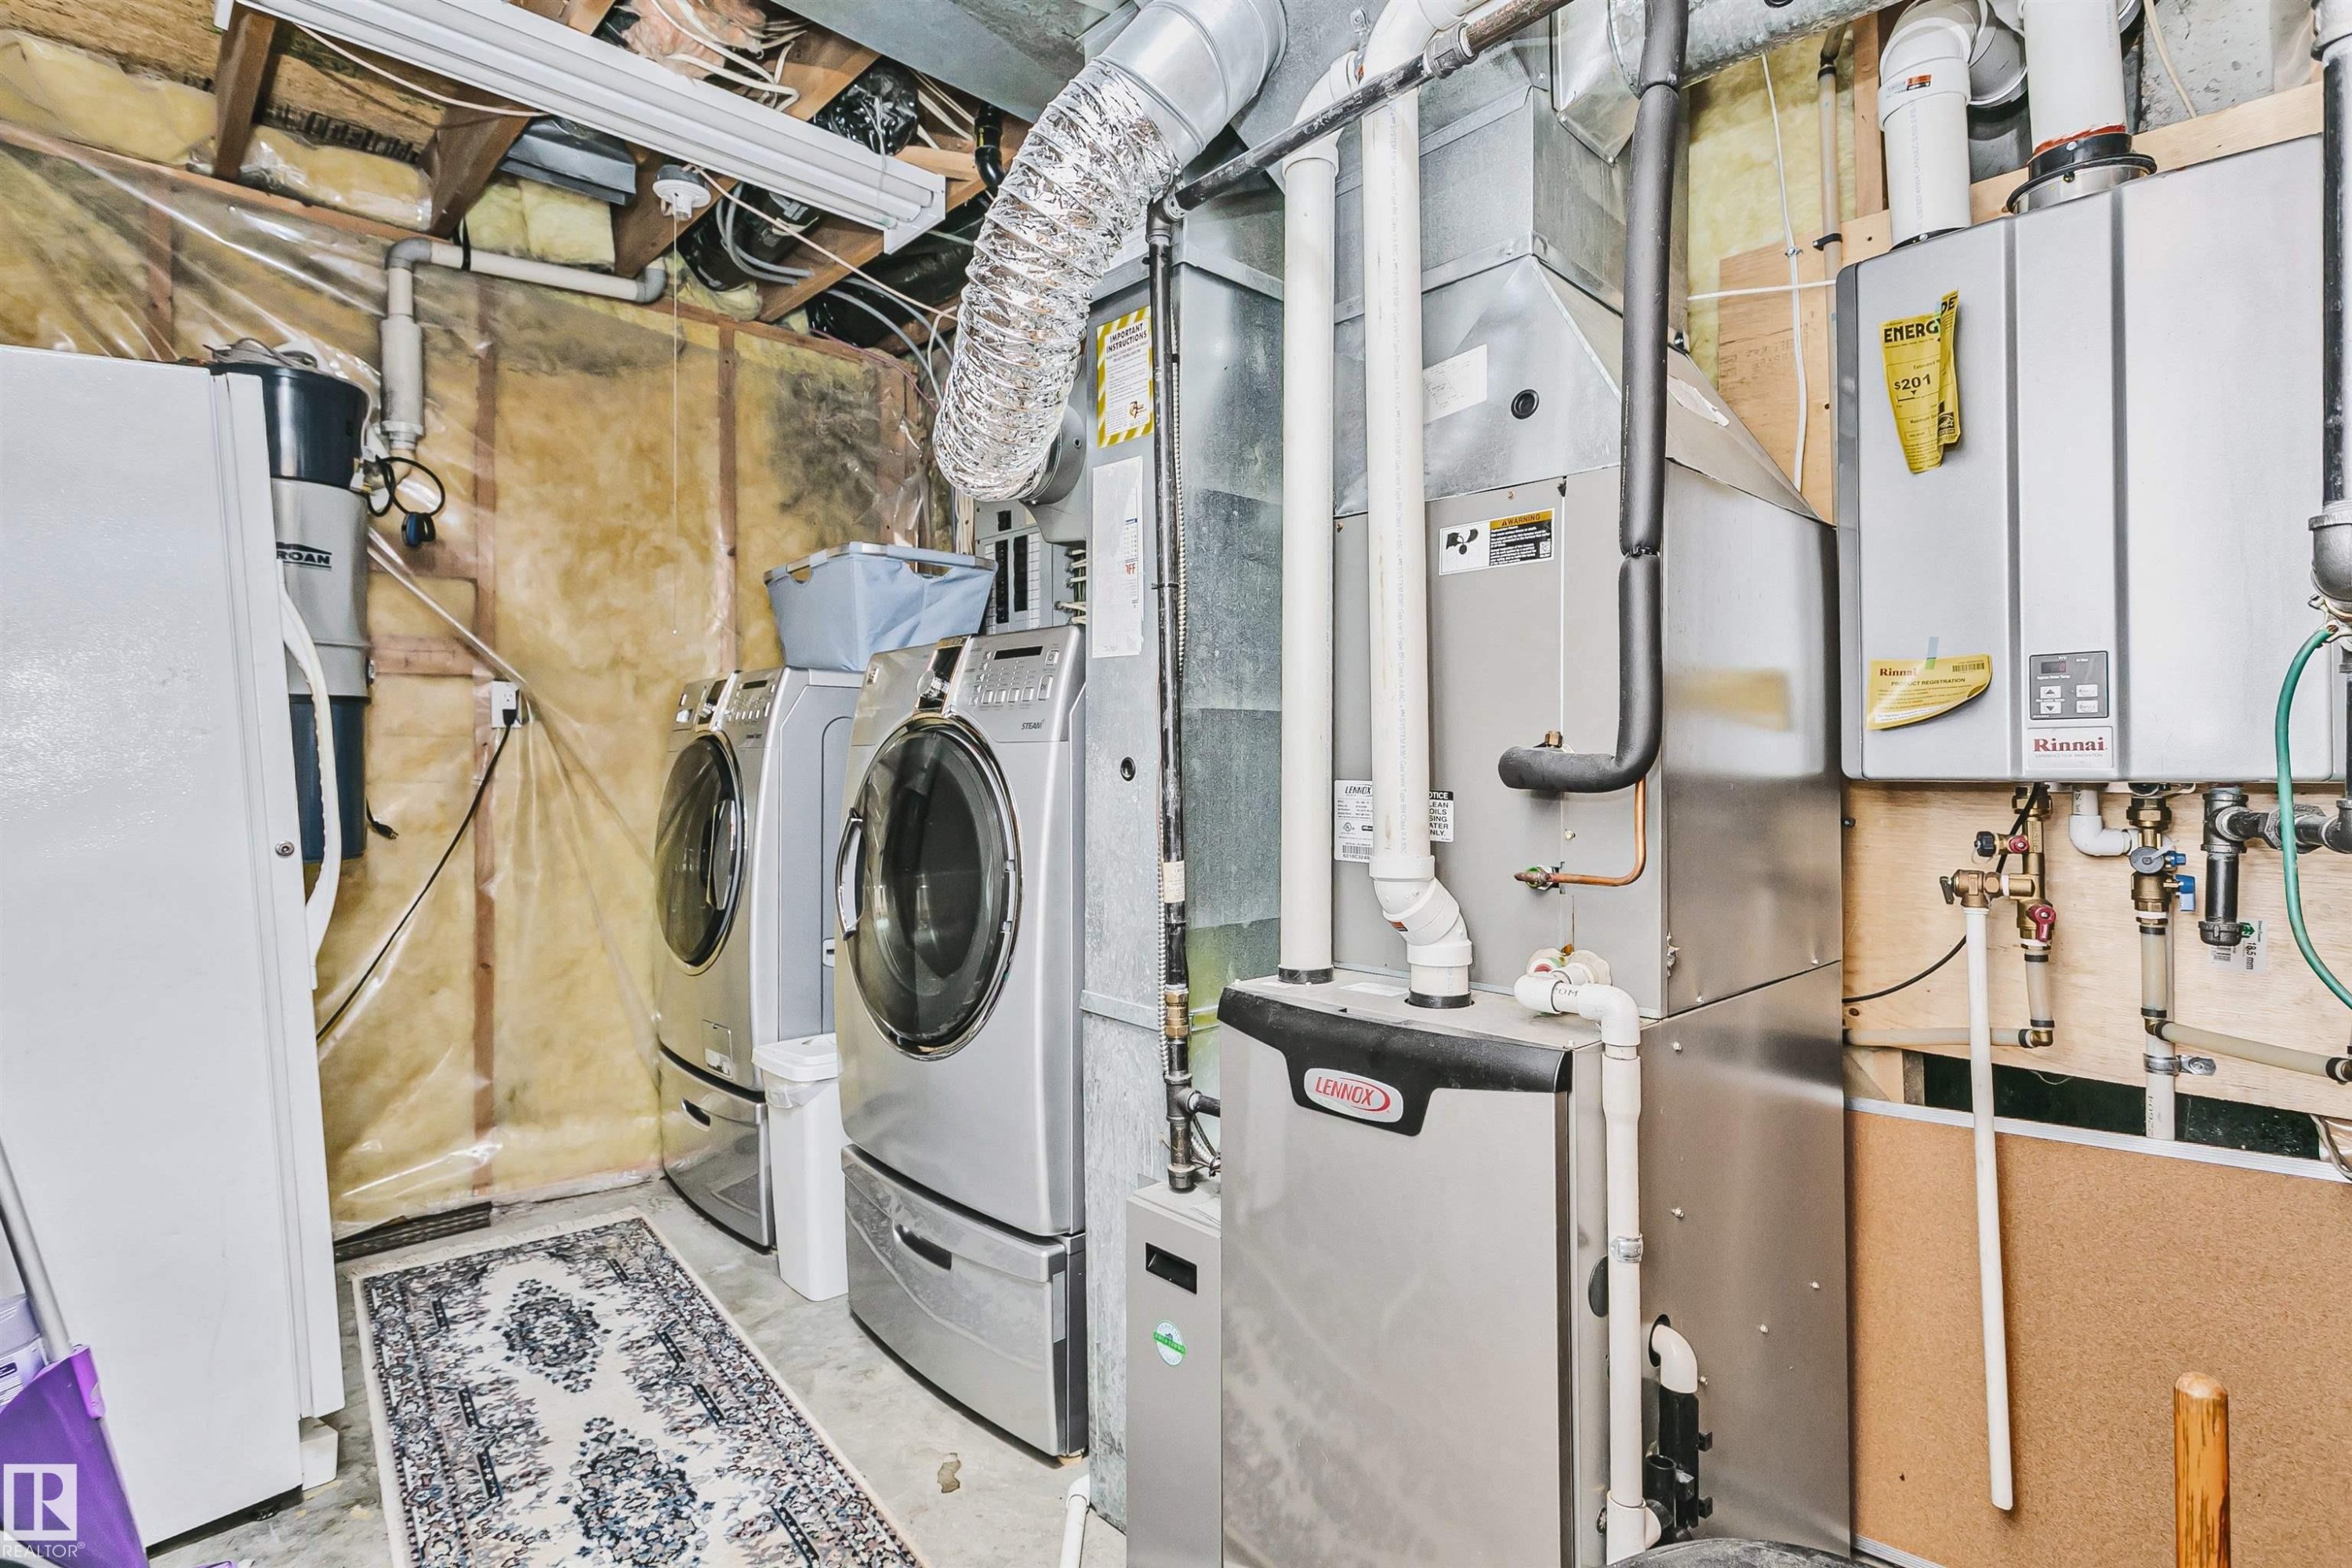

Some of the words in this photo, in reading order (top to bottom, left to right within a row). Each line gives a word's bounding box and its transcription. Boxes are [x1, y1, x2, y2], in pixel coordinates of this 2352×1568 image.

[1109, 322, 1143, 343] IMPORTANT
[1106, 330, 1147, 354] INSTRUCTIONS
[1894, 373, 1931, 390] $201
[1508, 514, 1541, 526] WARNING
[1022, 721, 1043, 730] STEAM
[2034, 737, 2105, 752] Rinnai
[1345, 786, 1371, 795] LENNOX
[1316, 1076, 1374, 1106] LENNOX
